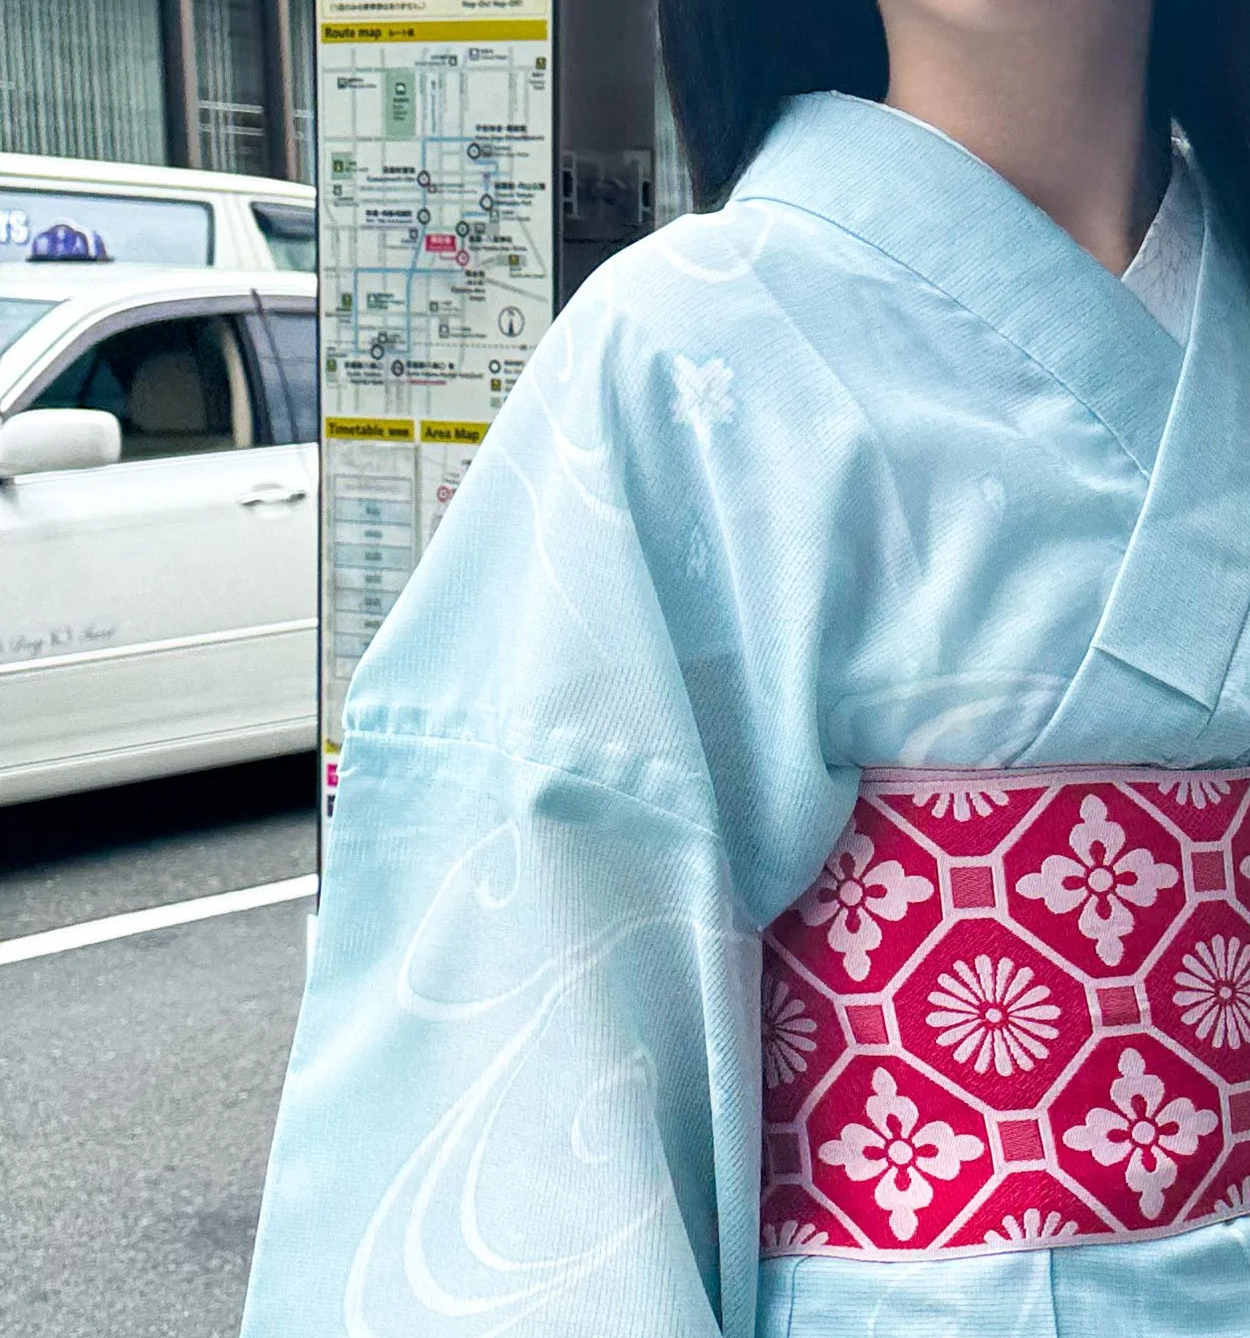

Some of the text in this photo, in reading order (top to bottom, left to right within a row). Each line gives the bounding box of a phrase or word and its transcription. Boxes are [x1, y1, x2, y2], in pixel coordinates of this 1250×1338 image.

[324, 27, 356, 39] Route
[358, 29, 382, 40] map
[328, 422, 385, 437] Timetable
[425, 427, 451, 440] Area
[453, 428, 480, 443] Map
